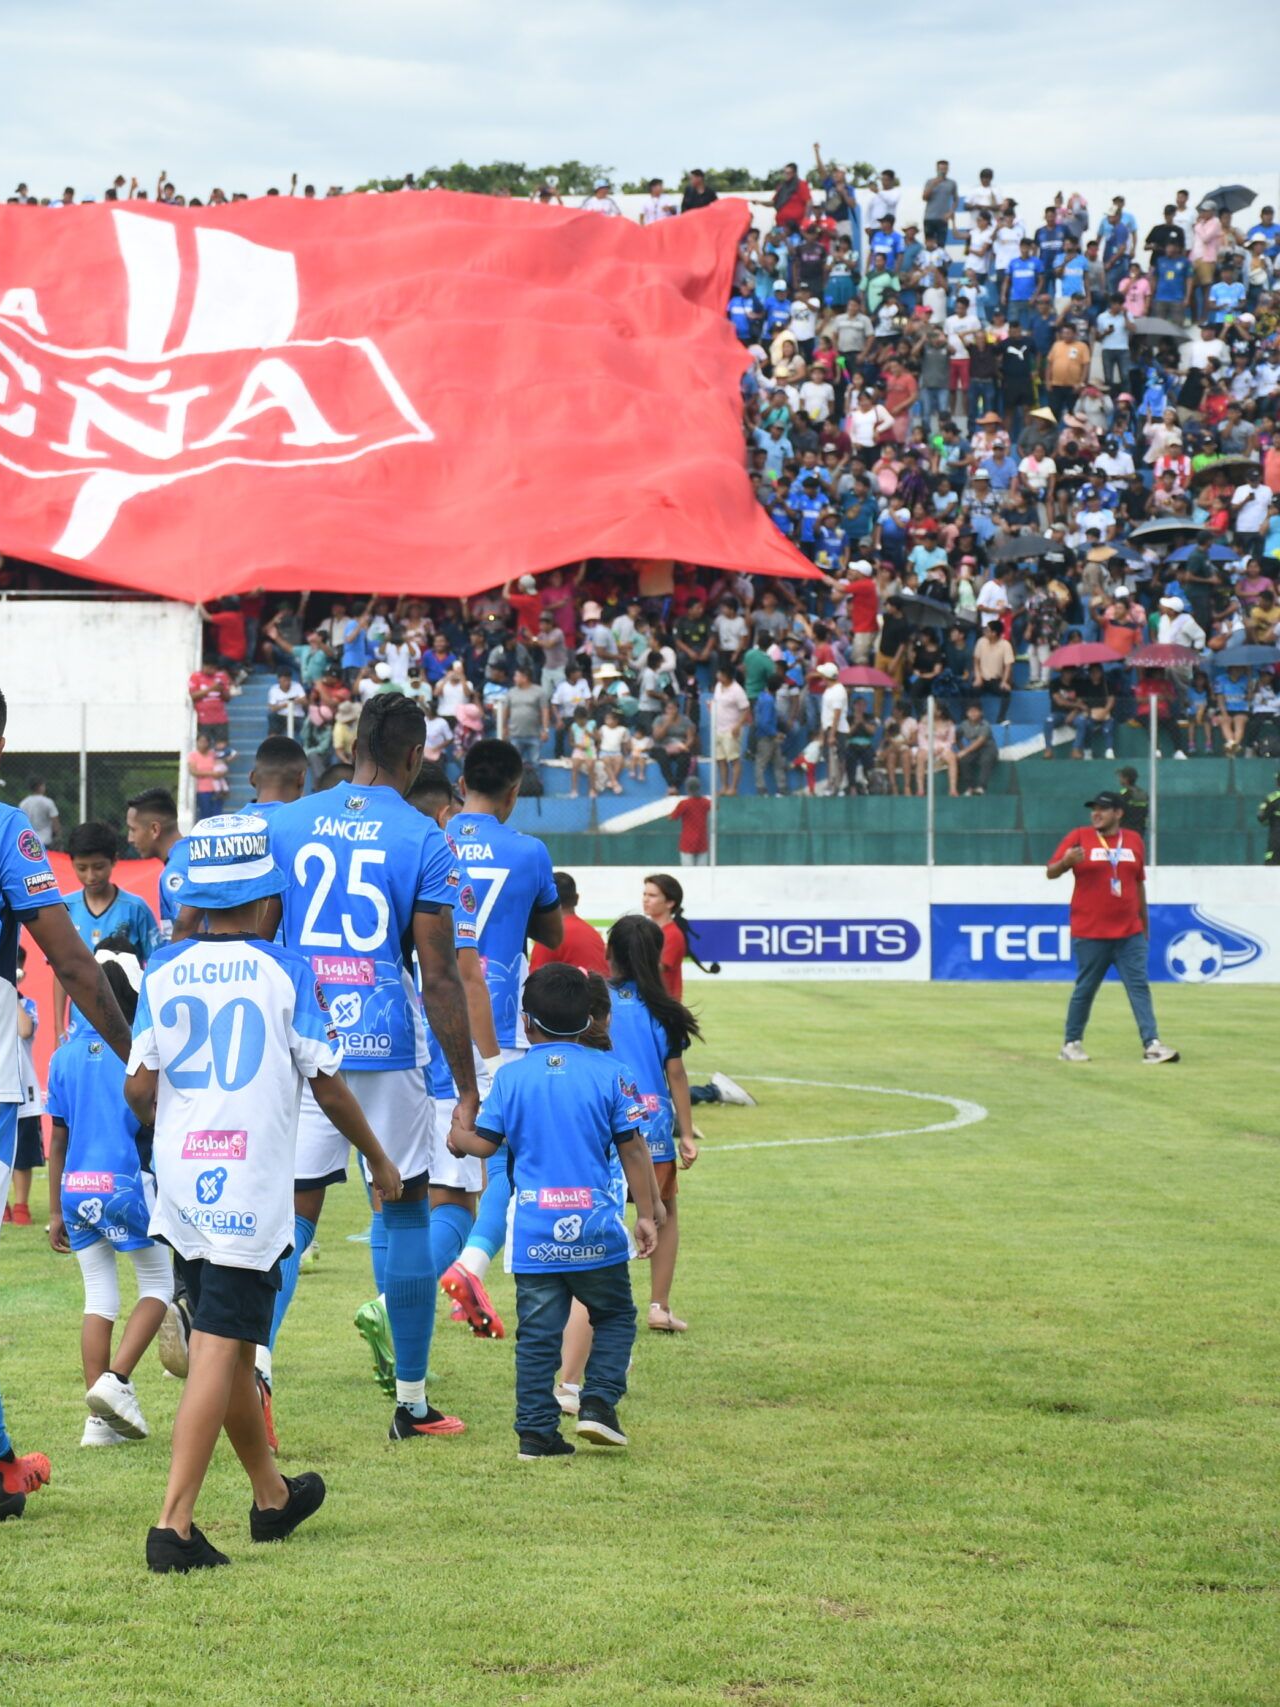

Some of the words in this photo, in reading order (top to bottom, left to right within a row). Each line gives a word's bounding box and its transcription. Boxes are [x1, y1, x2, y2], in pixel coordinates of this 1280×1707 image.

[312, 816, 383, 842] SANCHEZ
[189, 837, 211, 861] SAN
[293, 842, 390, 952] 25
[738, 925, 907, 956] RIGHTS
[173, 959, 258, 986] OLGUIN
[159, 994, 267, 1092] 20
